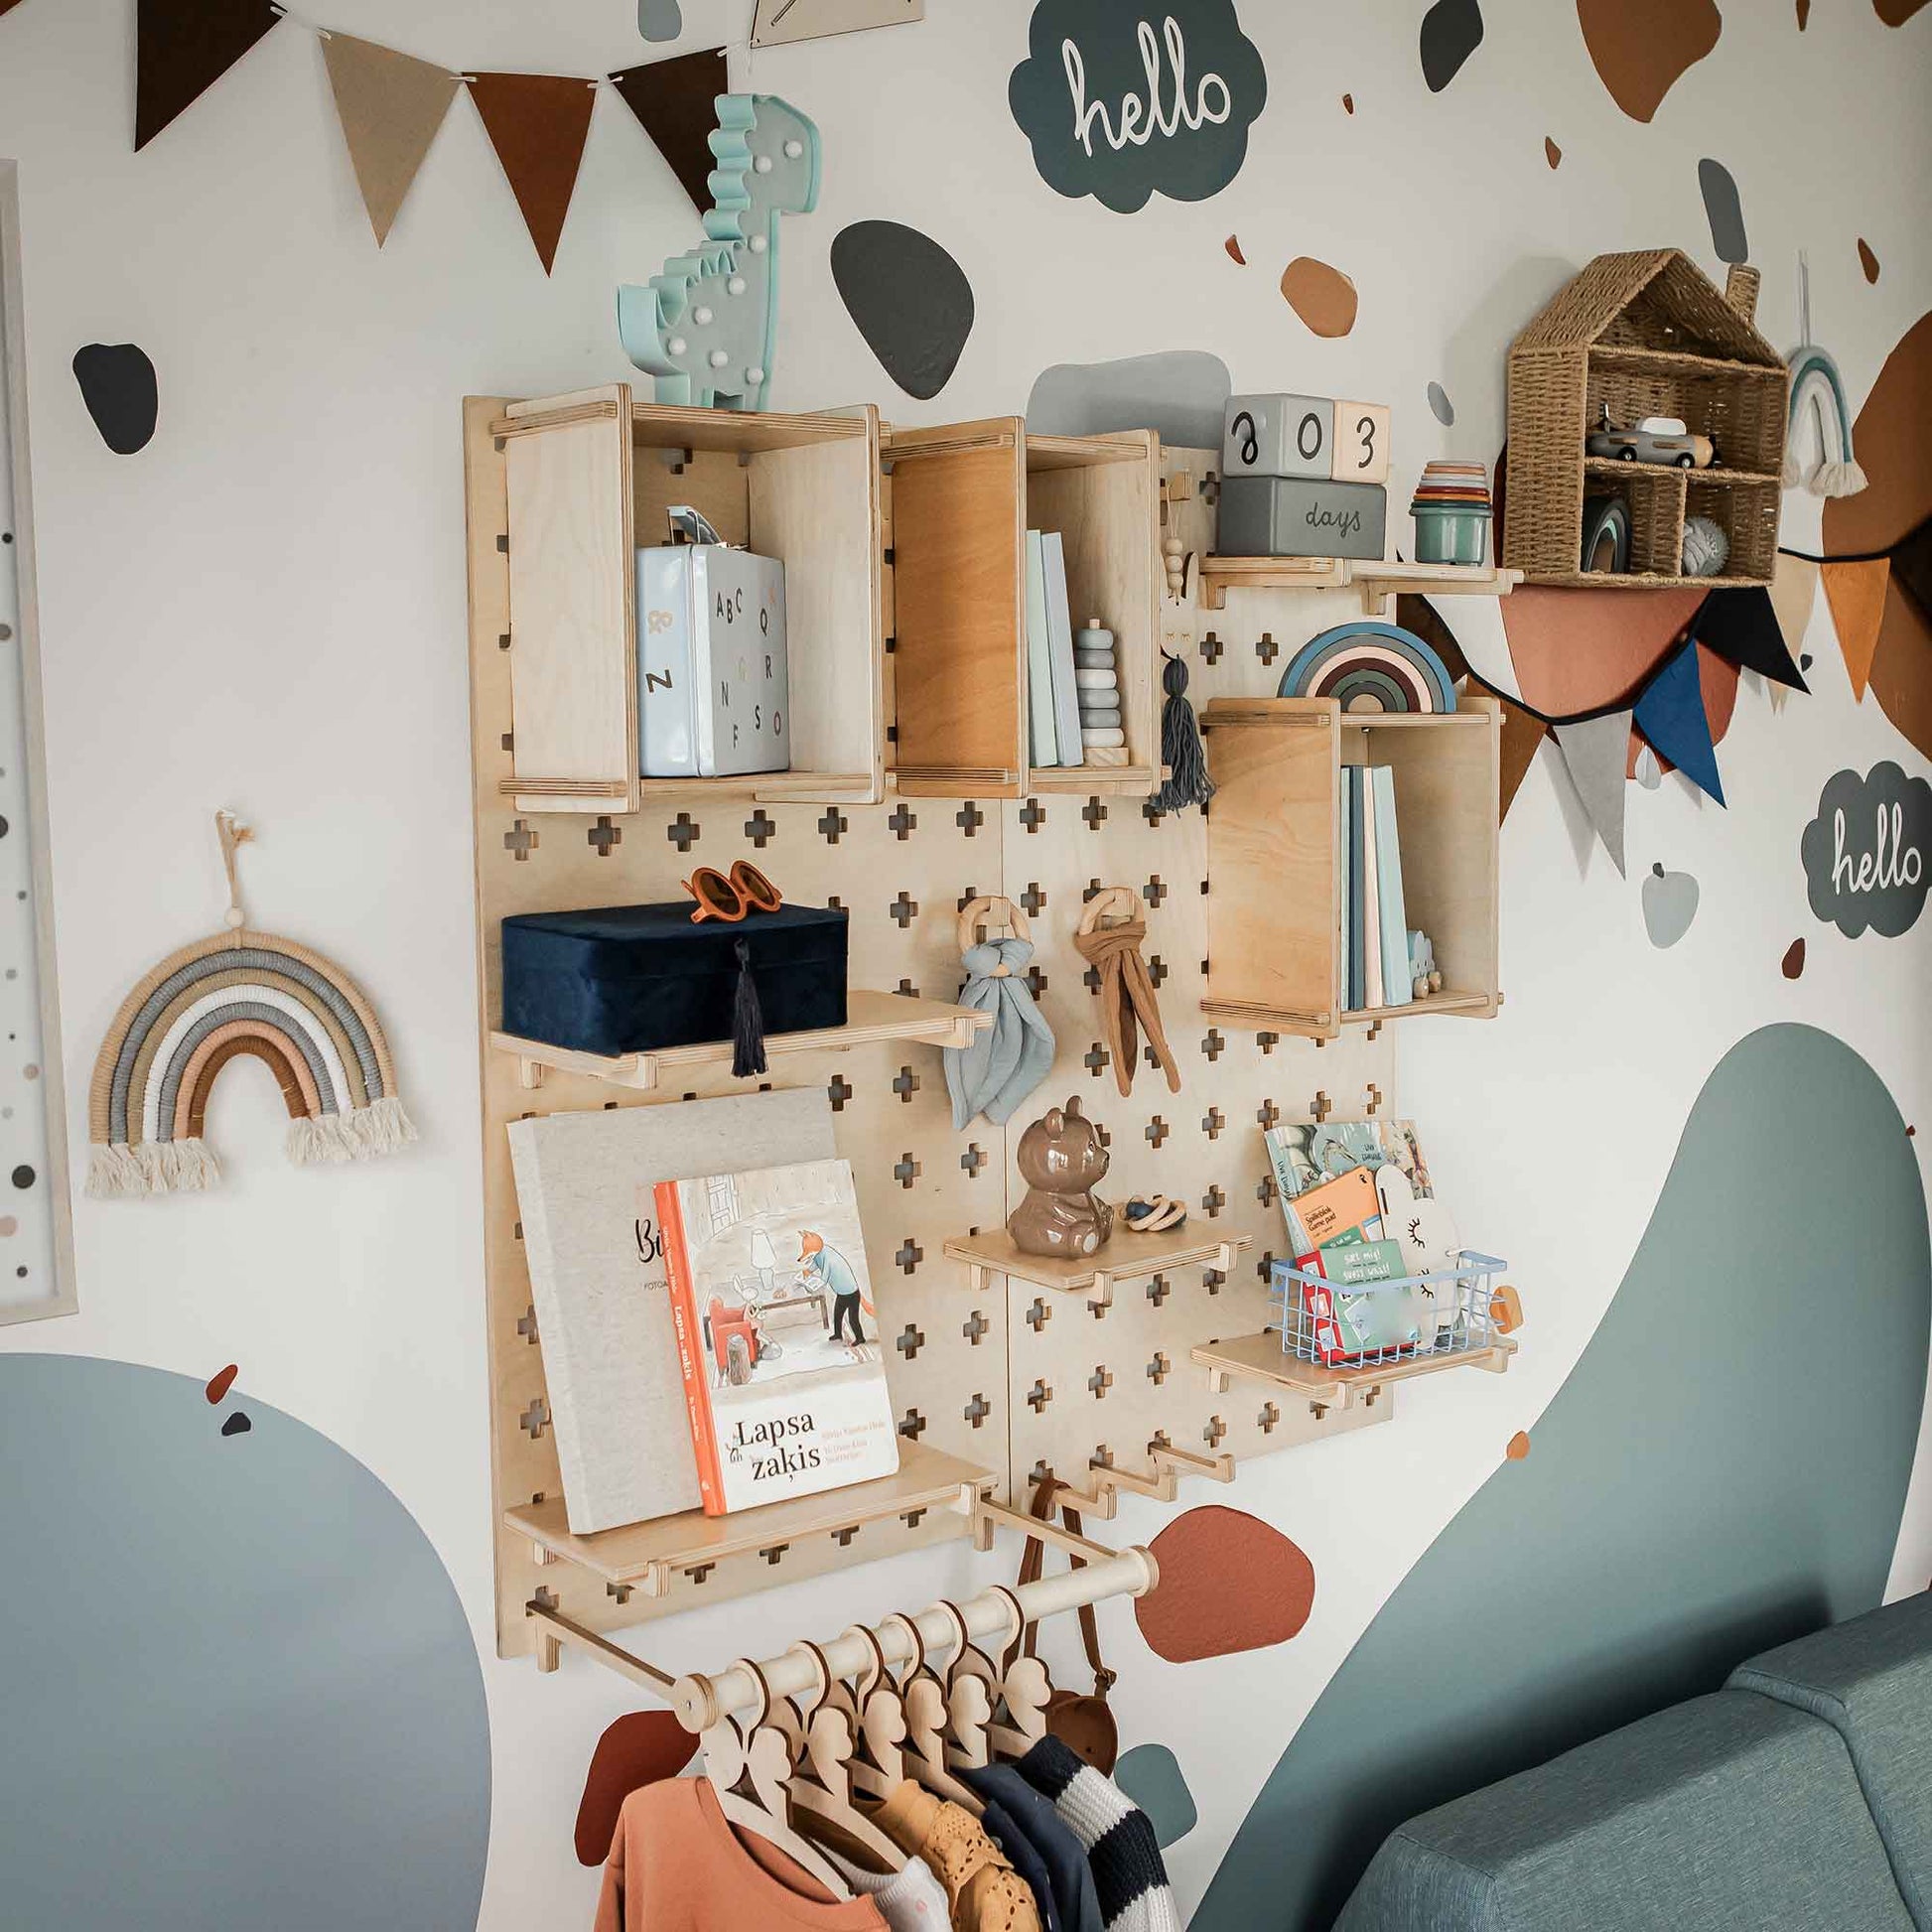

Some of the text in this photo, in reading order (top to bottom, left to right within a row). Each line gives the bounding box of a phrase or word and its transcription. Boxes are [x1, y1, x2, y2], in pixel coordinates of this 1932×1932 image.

[1061, 16, 1231, 157] hello
[1306, 501, 1360, 538] days
[755, 704, 761, 731] S
[1832, 802, 1922, 895] hello
[736, 1414, 814, 1448] Lapsa
[753, 1445, 820, 1483] zaķis
